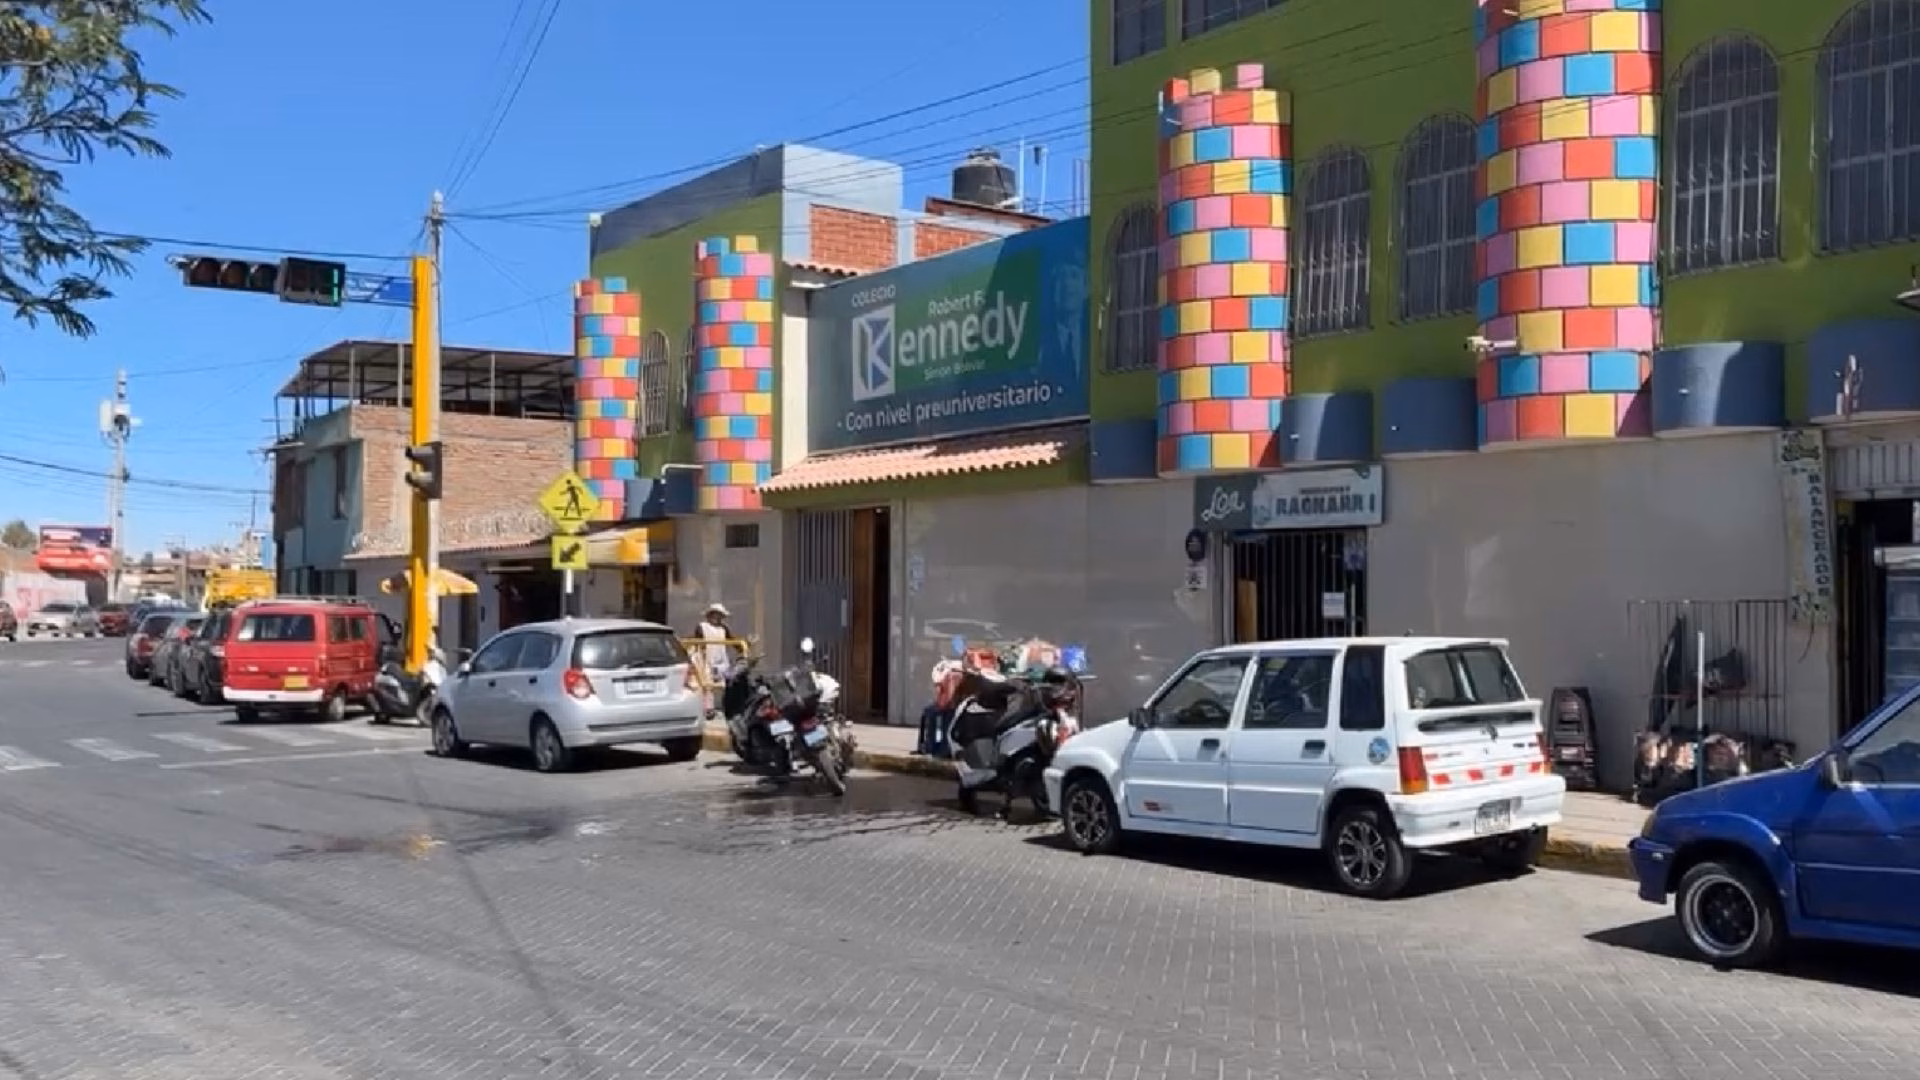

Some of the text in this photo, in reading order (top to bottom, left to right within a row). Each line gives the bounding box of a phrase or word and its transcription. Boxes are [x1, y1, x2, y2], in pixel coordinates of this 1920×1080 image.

[852, 284, 896, 307] COLEGIO
[928, 293, 971, 318] Robert
[853, 290, 1030, 400] Kennedy
[846, 380, 1051, 433] Con nivel preuniversitario
